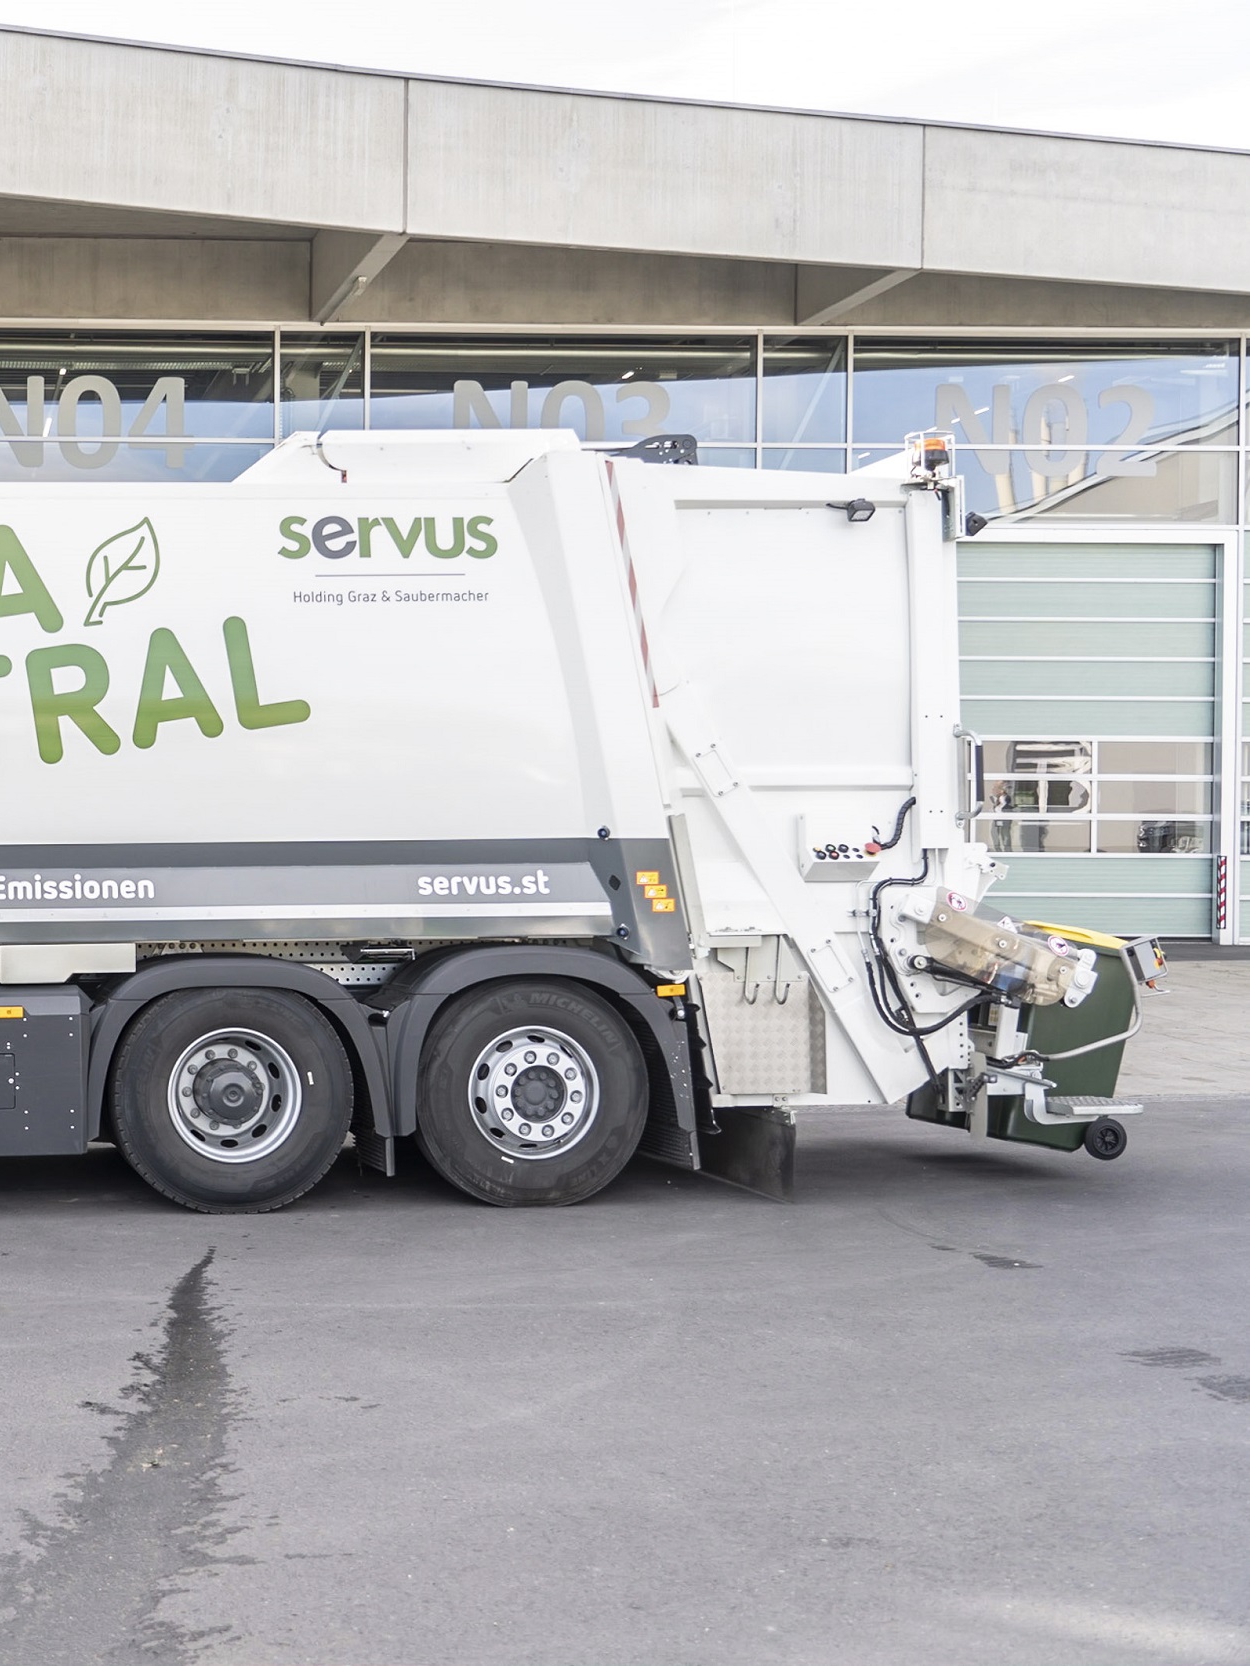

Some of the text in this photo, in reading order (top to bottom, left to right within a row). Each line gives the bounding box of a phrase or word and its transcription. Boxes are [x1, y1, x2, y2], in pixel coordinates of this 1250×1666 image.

[935, 383, 1157, 477] N02
[277, 515, 499, 560] servus
[293, 589, 490, 606] Holding Graz & Saubermacher
[417, 869, 550, 896] servus.st
[529, 992, 620, 1046] MICHELIN
